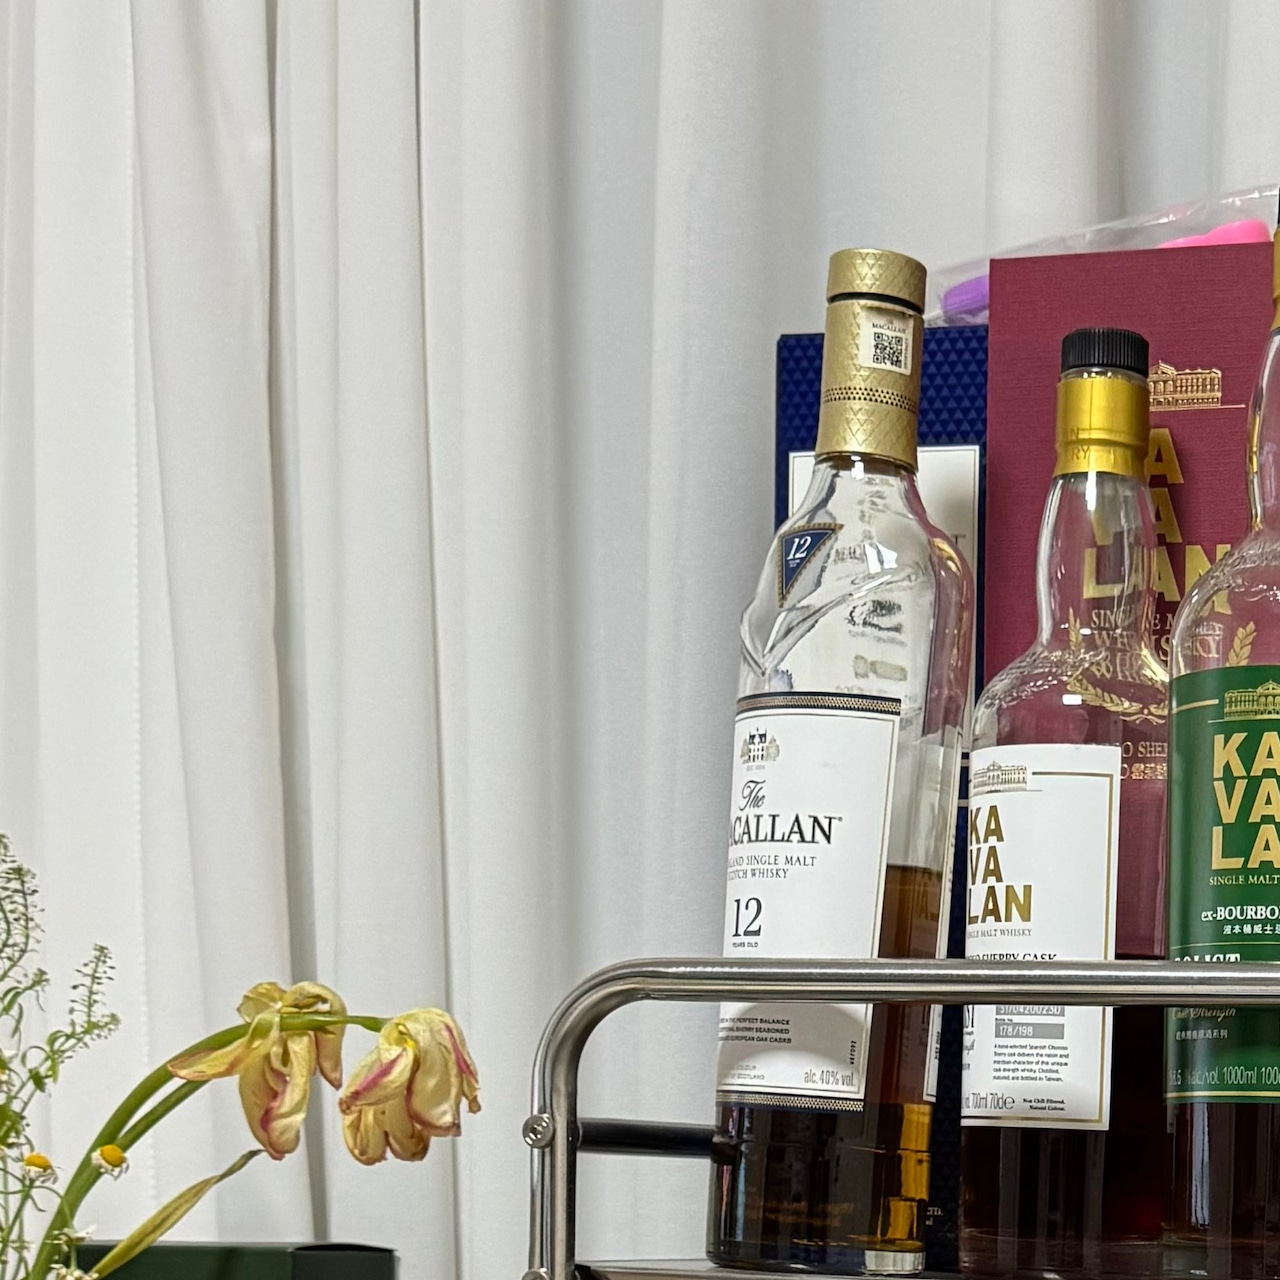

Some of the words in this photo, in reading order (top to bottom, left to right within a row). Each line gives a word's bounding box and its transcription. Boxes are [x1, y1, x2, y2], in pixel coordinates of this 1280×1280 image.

[872, 322, 907, 334] MACALLAN
[786, 535, 812, 561] 12
[738, 779, 767, 812] The
[970, 804, 1005, 846] KA
[746, 855, 780, 866] SINGLE
[784, 855, 817, 867] MALT
[970, 845, 1004, 886] VA
[750, 868, 789, 879] WHISKY
[1209, 875, 1245, 887] SINGLE
[1248, 874, 1280, 885] MALT
[968, 884, 1033, 926] LAN
[731, 897, 762, 938] 12
[999, 928, 1033, 938] WHISKY
[759, 1018, 790, 1026] BALANCE
[1000, 1026, 1034, 1037] 178/198
[820, 1070, 839, 1086] 40%
[1222, 1066, 1257, 1085] 1000ml
